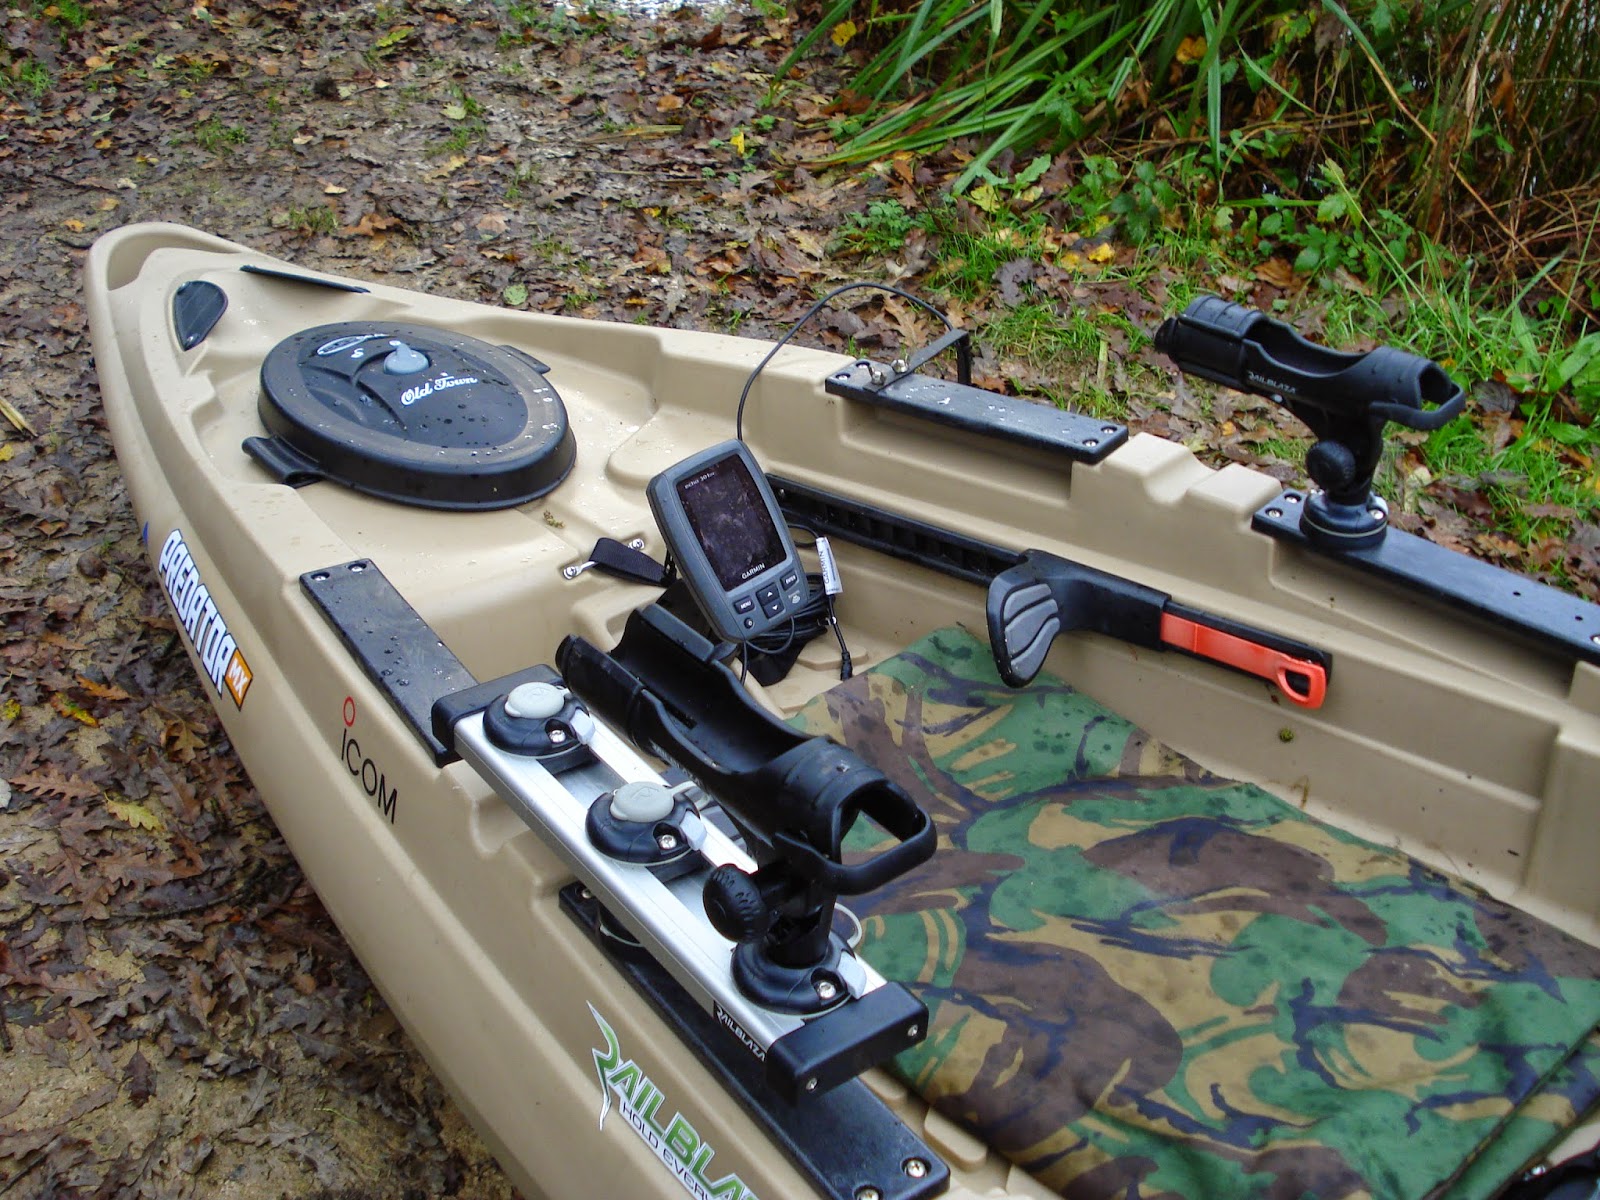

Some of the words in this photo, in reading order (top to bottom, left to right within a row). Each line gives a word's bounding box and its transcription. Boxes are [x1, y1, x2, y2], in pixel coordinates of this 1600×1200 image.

[401, 382, 433, 406] Old
[433, 374, 478, 391] Town
[741, 562, 765, 580] GARMIN
[819, 551, 830, 584] GARMIN
[158, 528, 238, 700] PREDATOR
[227, 657, 249, 695] MX
[740, 600, 752, 609] MENU
[715, 1006, 767, 1062] RAILBLAZA
[586, 1000, 759, 1199] RAILBLA
[622, 1102, 659, 1149] HOLD
